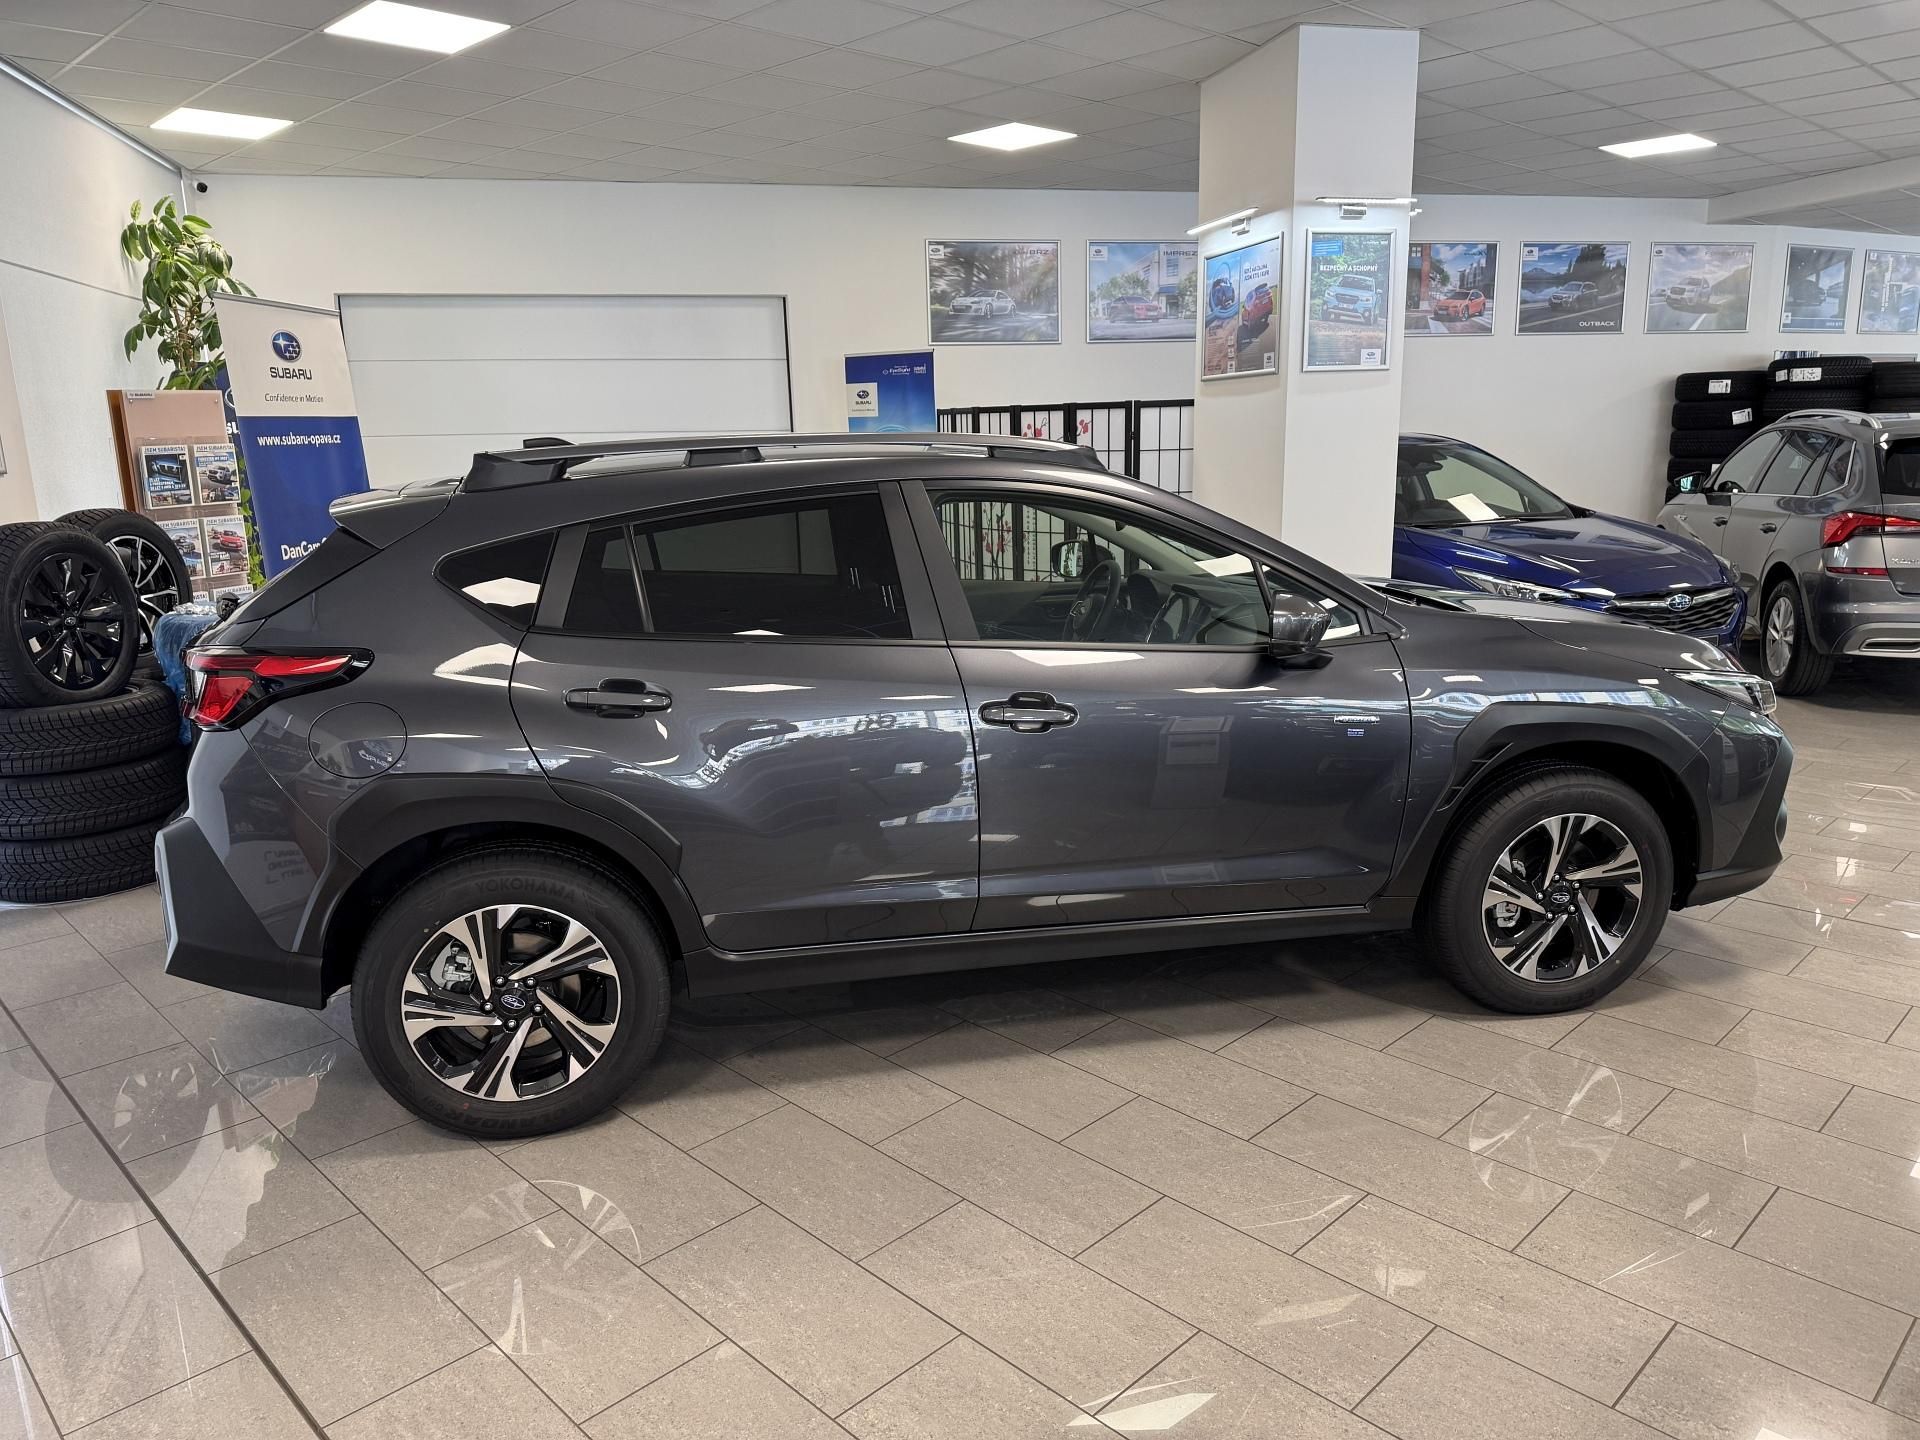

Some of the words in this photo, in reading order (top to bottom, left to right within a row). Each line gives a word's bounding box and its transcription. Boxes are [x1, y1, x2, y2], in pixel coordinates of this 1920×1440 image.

[269, 366, 313, 380] SUBARU
[264, 393, 299, 403] Confidence
[305, 395, 324, 403] Motion
[257, 431, 341, 447] www.subaru-opava.cz
[474, 877, 577, 903] YOKOHAMA
